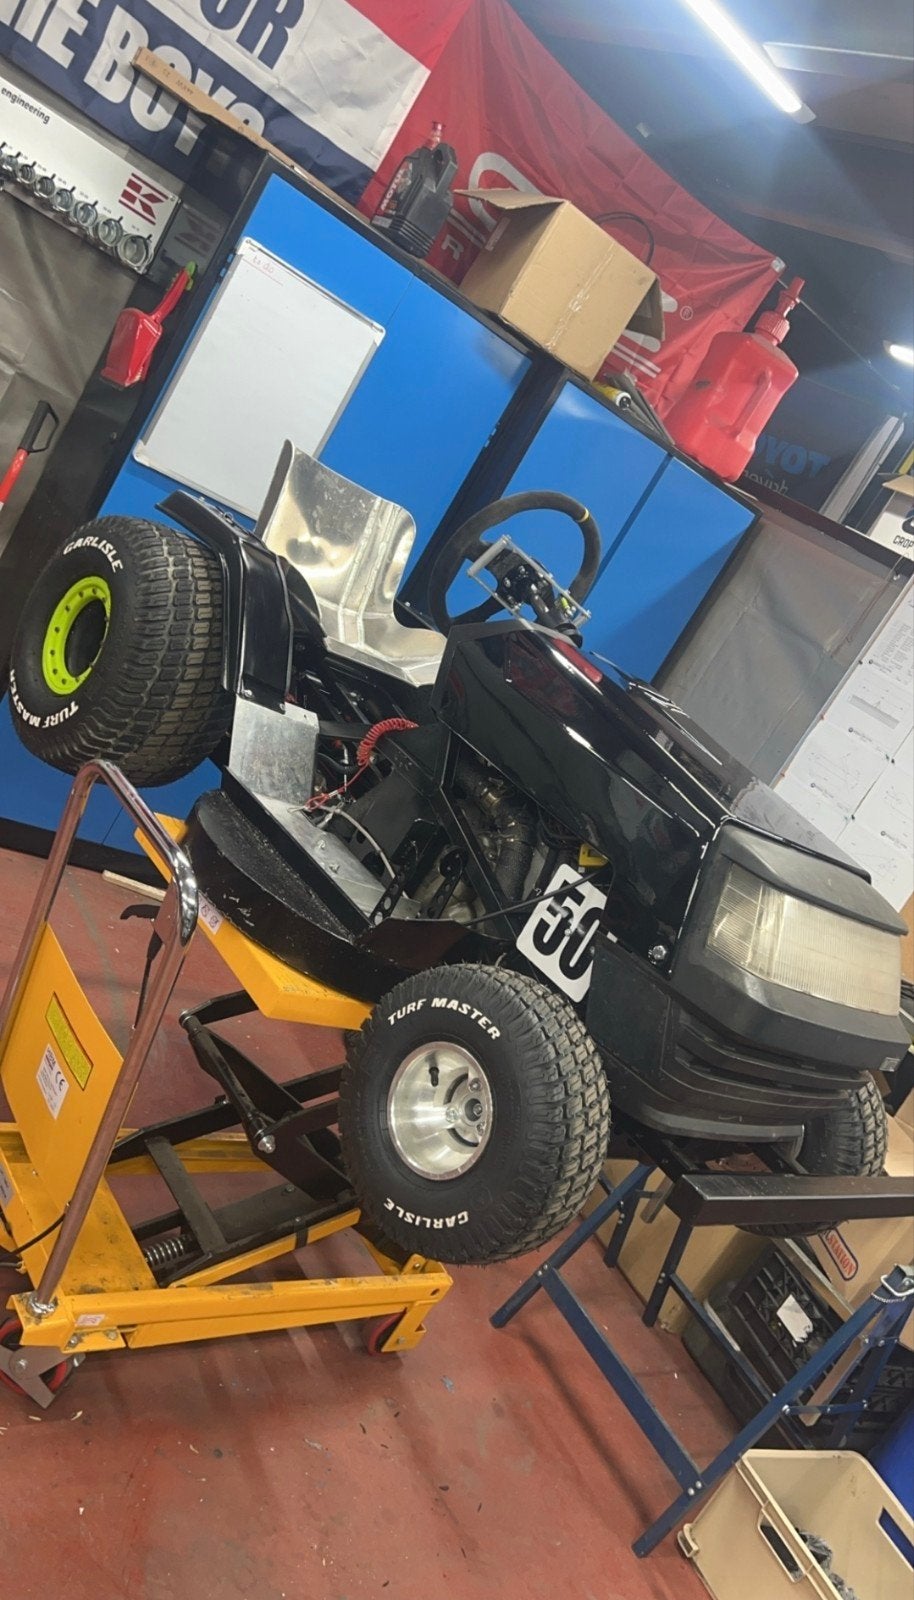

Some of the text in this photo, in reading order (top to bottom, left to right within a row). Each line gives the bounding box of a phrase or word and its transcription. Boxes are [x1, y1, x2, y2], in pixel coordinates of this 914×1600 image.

[1, 86, 51, 125] engineering
[63, 536, 124, 573] CARLISLE
[42, 700, 79, 729] TURF
[532, 879, 605, 981] 50
[387, 997, 501, 1040] TURF MASTER
[383, 1197, 469, 1229] CARLISLE
